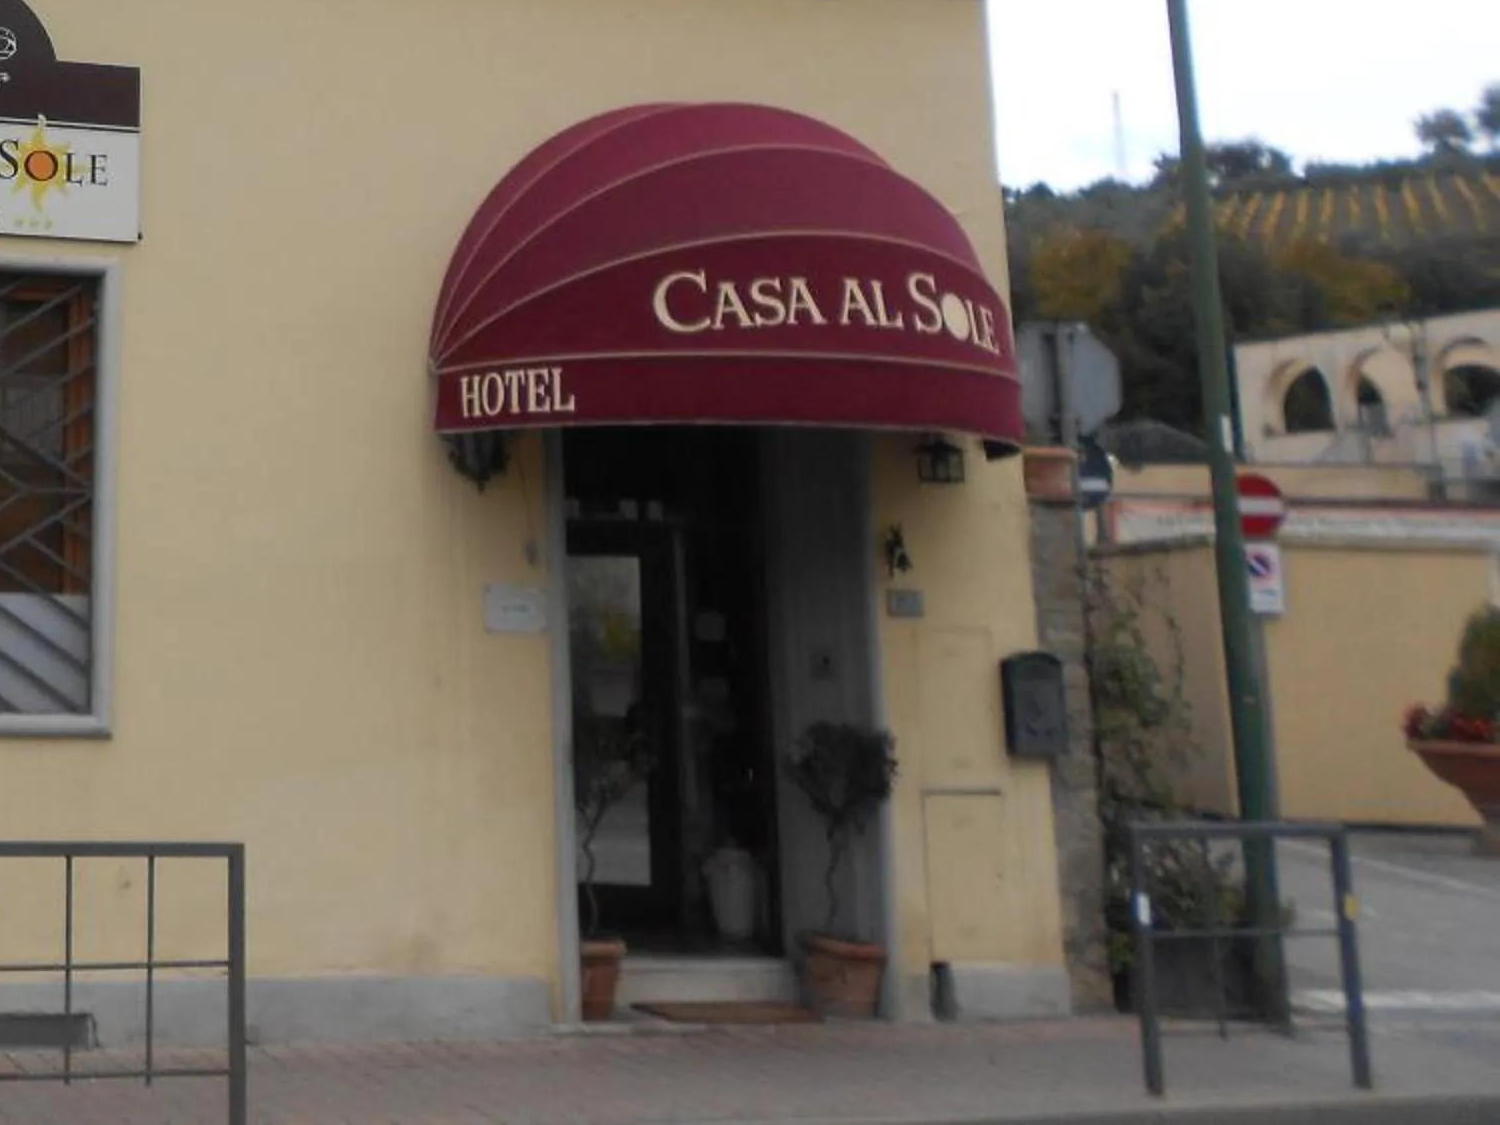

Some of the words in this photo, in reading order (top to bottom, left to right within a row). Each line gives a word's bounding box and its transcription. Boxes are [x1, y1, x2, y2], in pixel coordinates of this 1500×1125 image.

[652, 269, 828, 333] CASA
[841, 278, 905, 331] AL
[460, 366, 576, 419] HOTEL
